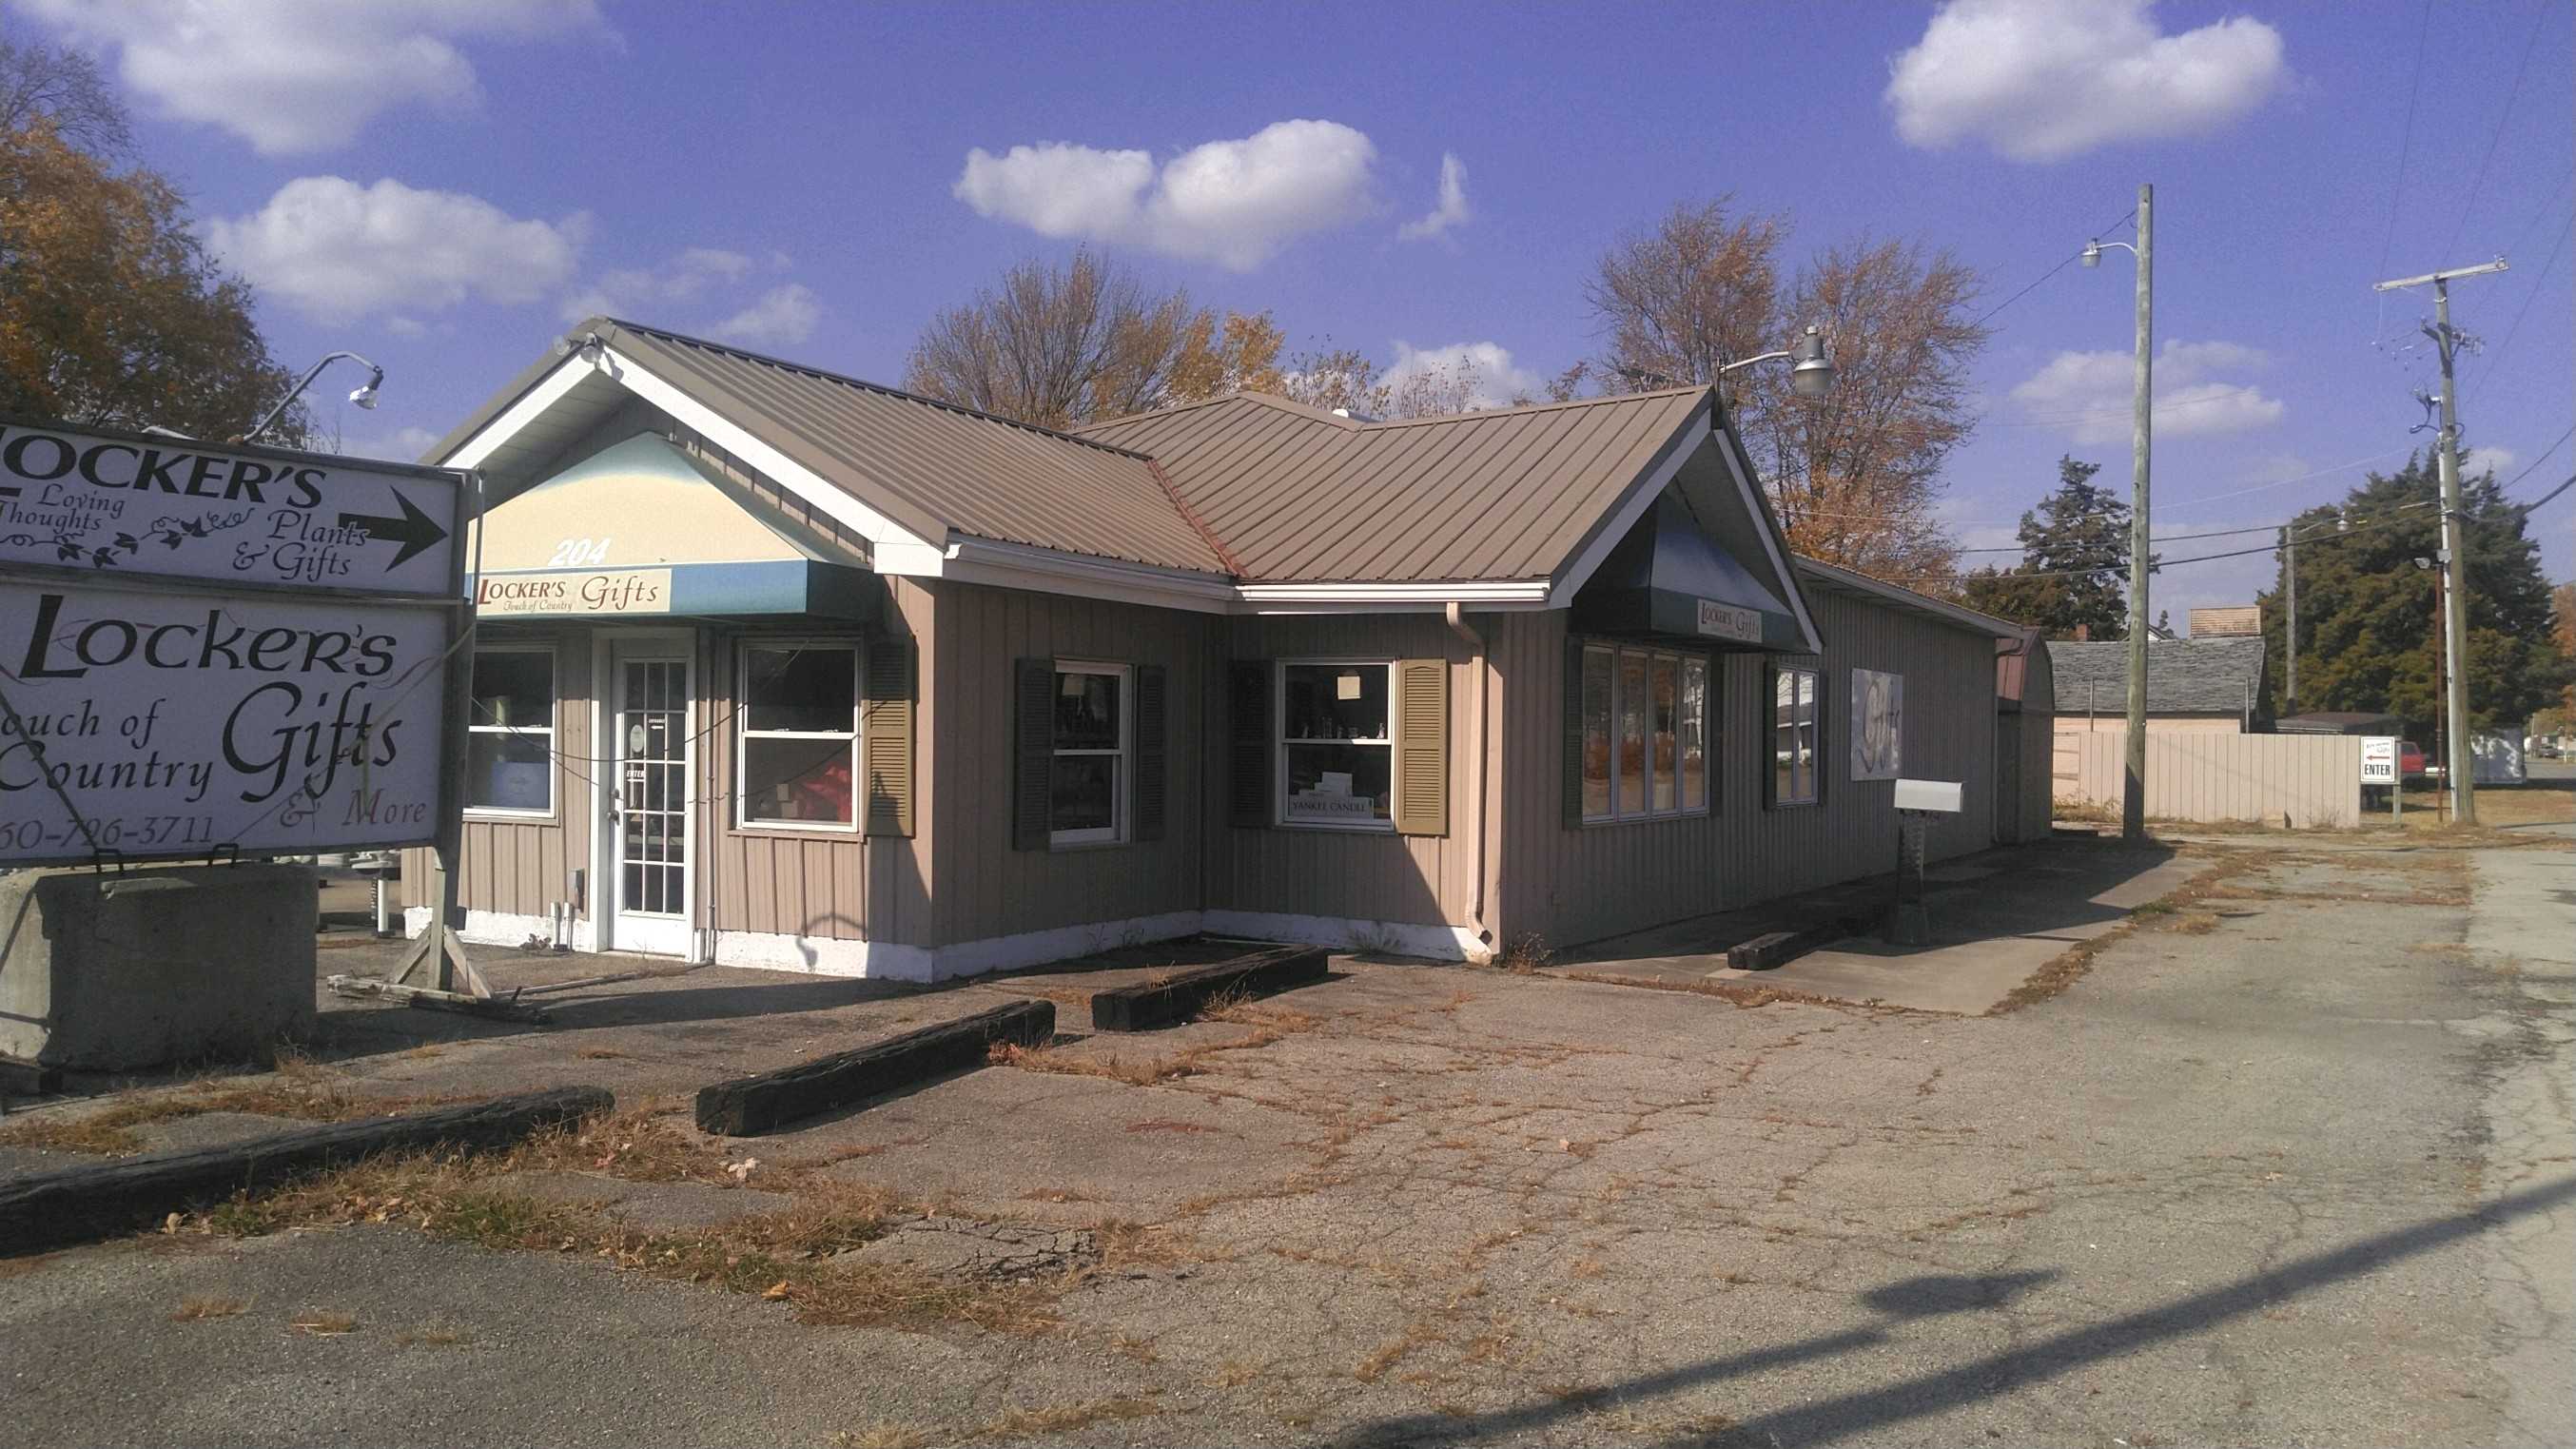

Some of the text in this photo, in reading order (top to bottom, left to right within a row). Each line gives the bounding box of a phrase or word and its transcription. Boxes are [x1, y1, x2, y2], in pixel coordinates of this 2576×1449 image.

[0, 427, 326, 510] OCKER'S
[37, 483, 126, 519] Loving
[267, 510, 367, 547] Plants
[233, 542, 351, 582] & Gifts
[548, 538, 612, 566] 204
[580, 575, 659, 611] Gifts
[1, 697, 166, 750] ouch of
[223, 681, 402, 802] Gifts
[0, 740, 213, 802] Country
[2365, 764, 2391, 775] ENTER
[280, 788, 428, 828] & More
